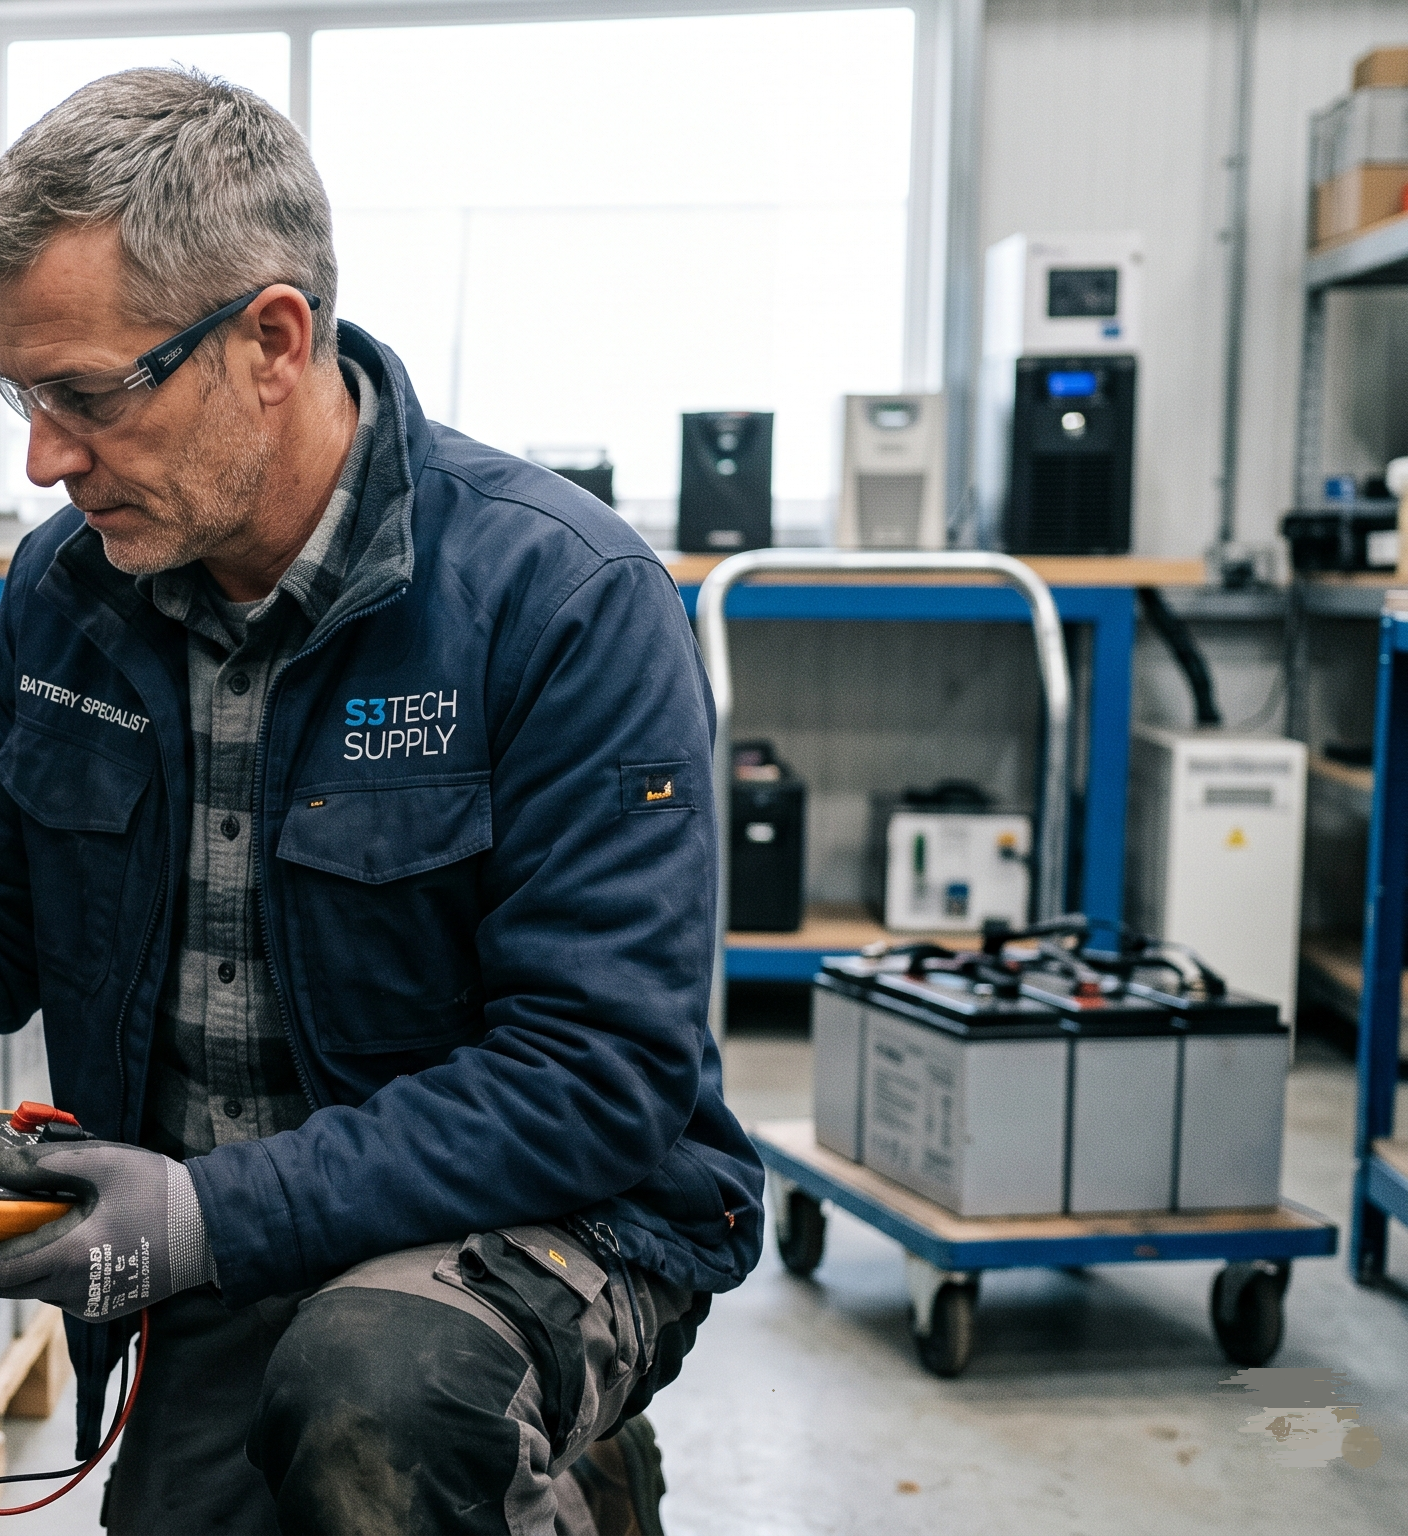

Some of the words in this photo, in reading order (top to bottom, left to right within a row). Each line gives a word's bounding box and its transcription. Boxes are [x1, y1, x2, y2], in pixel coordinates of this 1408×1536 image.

[19, 674, 81, 708] BATTERY
[81, 697, 149, 733] SPECIALIST
[343, 723, 457, 760] SUPPLY
